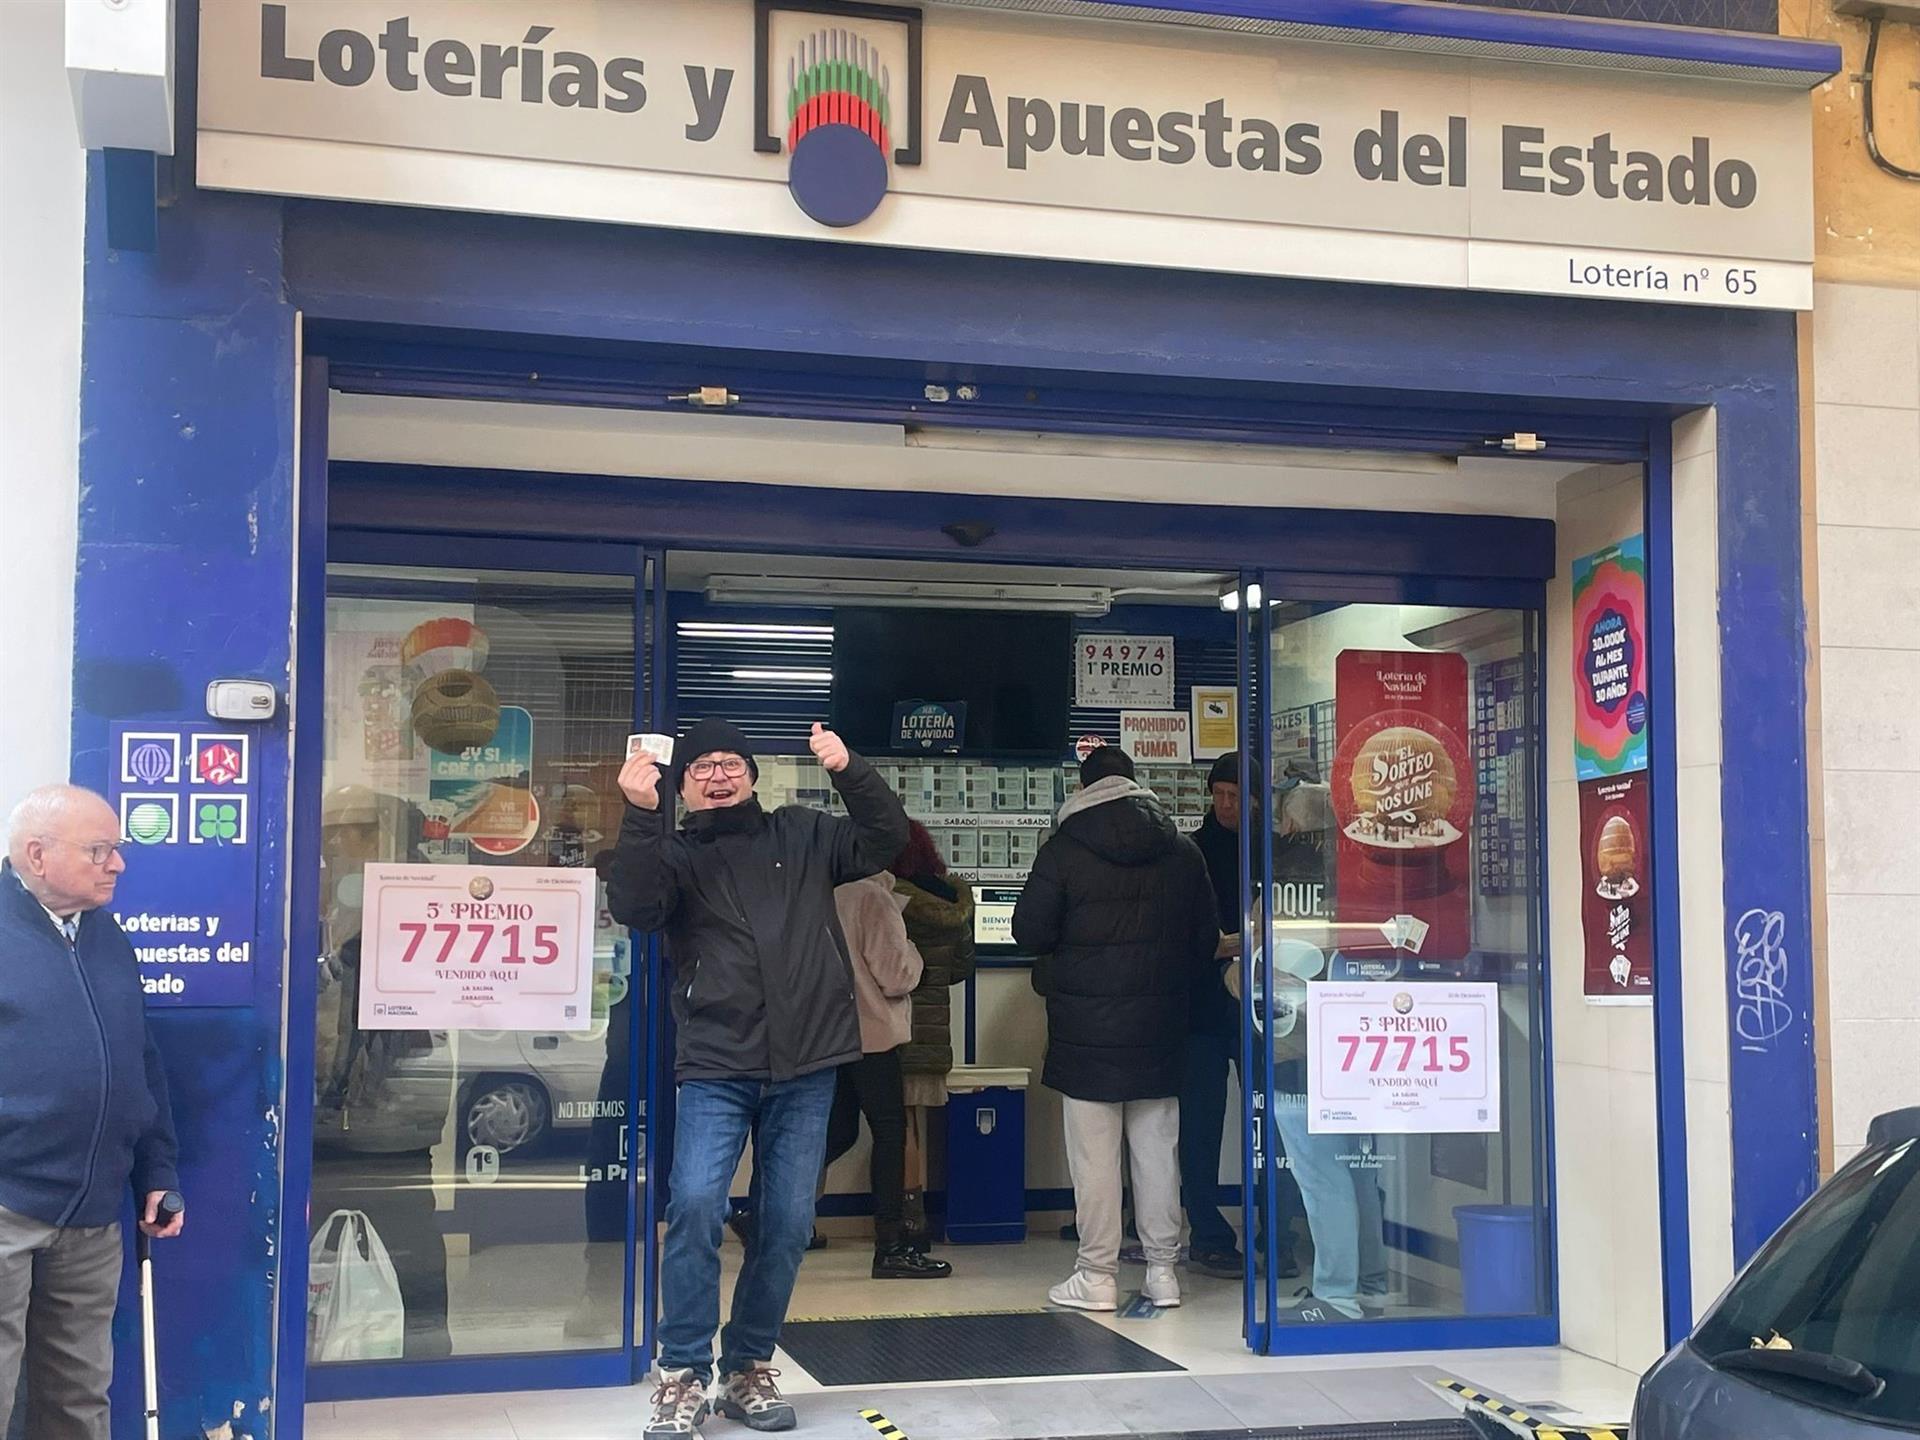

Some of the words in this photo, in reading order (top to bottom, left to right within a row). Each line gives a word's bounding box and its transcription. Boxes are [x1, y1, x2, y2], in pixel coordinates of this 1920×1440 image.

[261, 3, 647, 114] Loterías
[683, 64, 735, 142] y
[938, 74, 1322, 175] Apuestas
[1354, 109, 1466, 187] del
[1502, 125, 1757, 208] Estado
[1569, 258, 1668, 290] Lotería
[1725, 269, 1757, 294] 65
[1594, 616, 1622, 635] AHORA
[1085, 645, 1165, 661] 94974
[1608, 648, 1623, 664] MES
[1101, 662, 1163, 676] PREMIO
[1592, 664, 1629, 686] DURANTE
[1596, 688, 1606, 703] 30
[1607, 682, 1628, 700] AÑOS
[902, 711, 955, 729] LOTERÍA
[1124, 717, 1186, 732] PROHIBIDO
[900, 729, 913, 739] DE
[914, 729, 955, 739] NAVIDAD
[1134, 741, 1178, 758] FUMAR
[1400, 745, 1415, 761] EL
[1369, 750, 1434, 787] SORTEO
[1375, 792, 1402, 815] NOS
[1403, 780, 1433, 806] UNE
[450, 902, 534, 920] PREMIO
[206, 918, 219, 937] y
[134, 947, 211, 963] puestas
[217, 942, 250, 963] del
[399, 923, 560, 966] 77715
[435, 969, 487, 981] VENDIDO
[1378, 1016, 1448, 1033] PREMIO
[1338, 1036, 1471, 1072] 77715
[1369, 1077, 1412, 1087] VENDIDO
[559, 1102, 573, 1119] NO
[577, 1101, 625, 1118] TENEMOS
[579, 1165, 602, 1181] La
